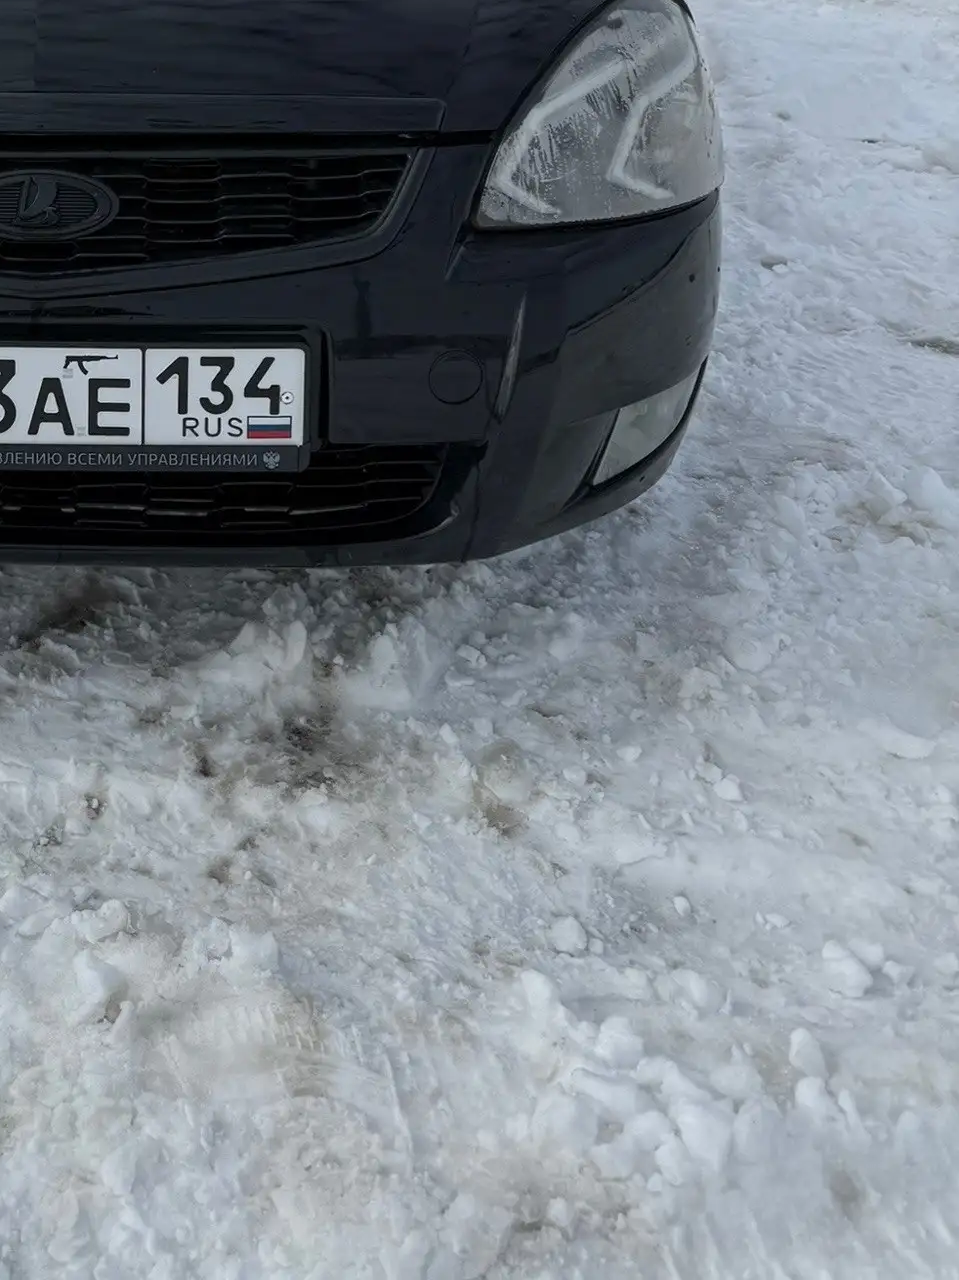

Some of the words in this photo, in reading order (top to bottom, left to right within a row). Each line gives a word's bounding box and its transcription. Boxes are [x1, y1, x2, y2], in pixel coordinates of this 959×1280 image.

[155, 355, 282, 415] 134
[182, 417, 244, 438] RUS
[67, 452, 123, 466] ВСЕМИ
[127, 453, 259, 467] УПРАВЛЕНИЯМИ
